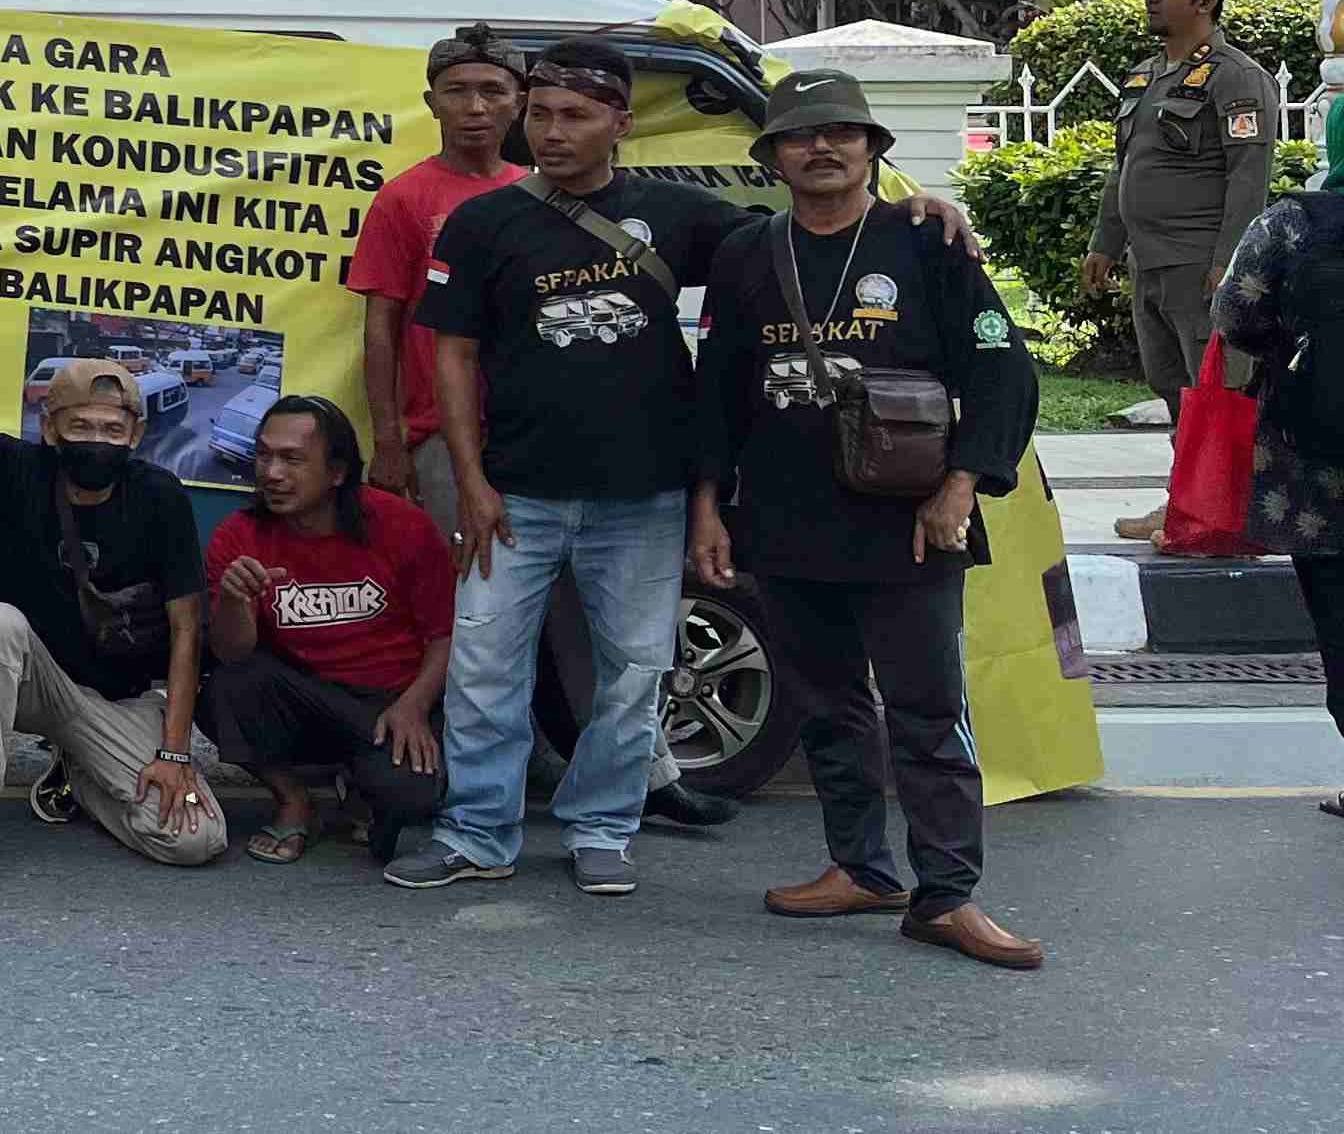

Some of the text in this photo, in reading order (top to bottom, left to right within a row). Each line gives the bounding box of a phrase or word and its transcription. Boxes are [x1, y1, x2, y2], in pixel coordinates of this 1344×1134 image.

[44, 37, 170, 78] GARA
[31, 82, 89, 116] KE
[104, 89, 393, 145] BALIKPAPAN
[52, 131, 385, 193] KONDUSIFITAS
[160, 189, 220, 226] INI
[234, 195, 328, 236] KITA
[14, 225, 143, 264] SUPIR
[155, 238, 328, 282] ANGKOT
[278, 582, 382, 624] KREATOR
